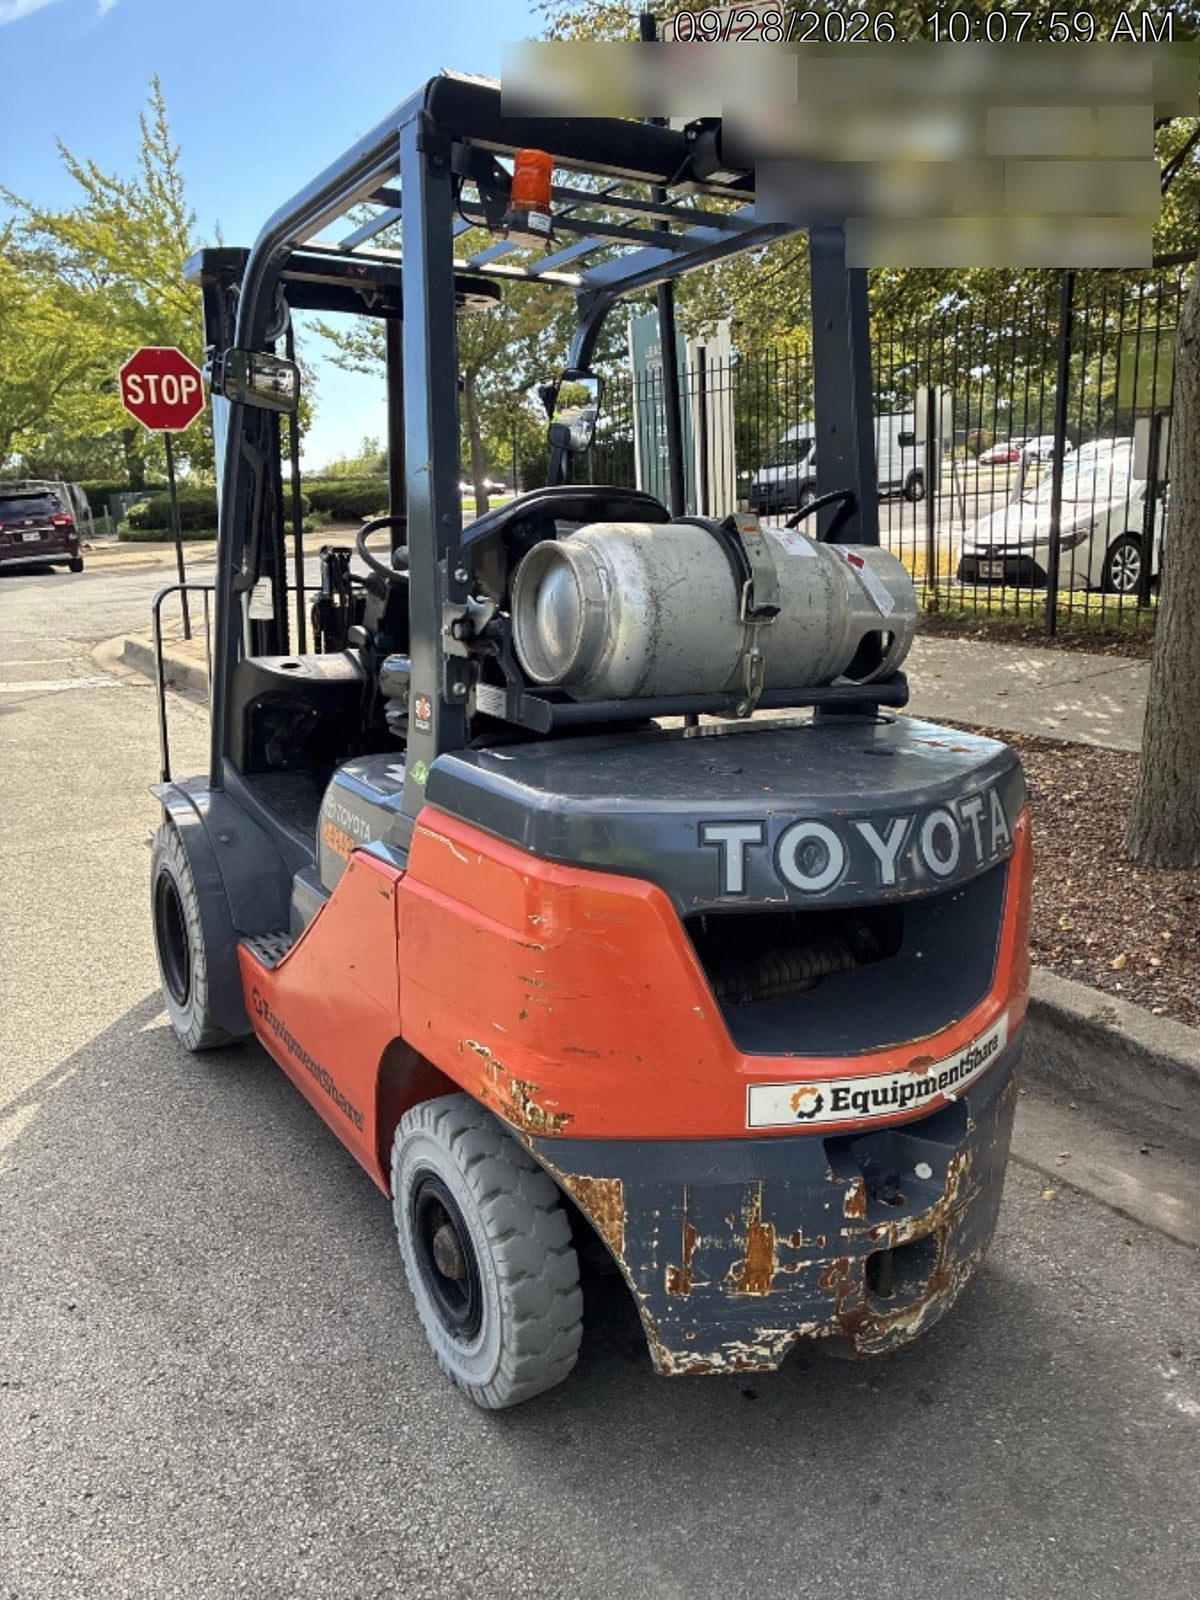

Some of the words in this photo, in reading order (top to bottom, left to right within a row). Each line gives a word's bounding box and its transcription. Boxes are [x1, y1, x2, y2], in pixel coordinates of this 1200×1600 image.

[126, 374, 199, 405] STOP
[337, 803, 371, 843] TOYOTA
[702, 788, 1012, 893] TOYOTA
[263, 999, 365, 1132] EquipmentShare
[831, 1033, 1000, 1112] EquipmentShare
